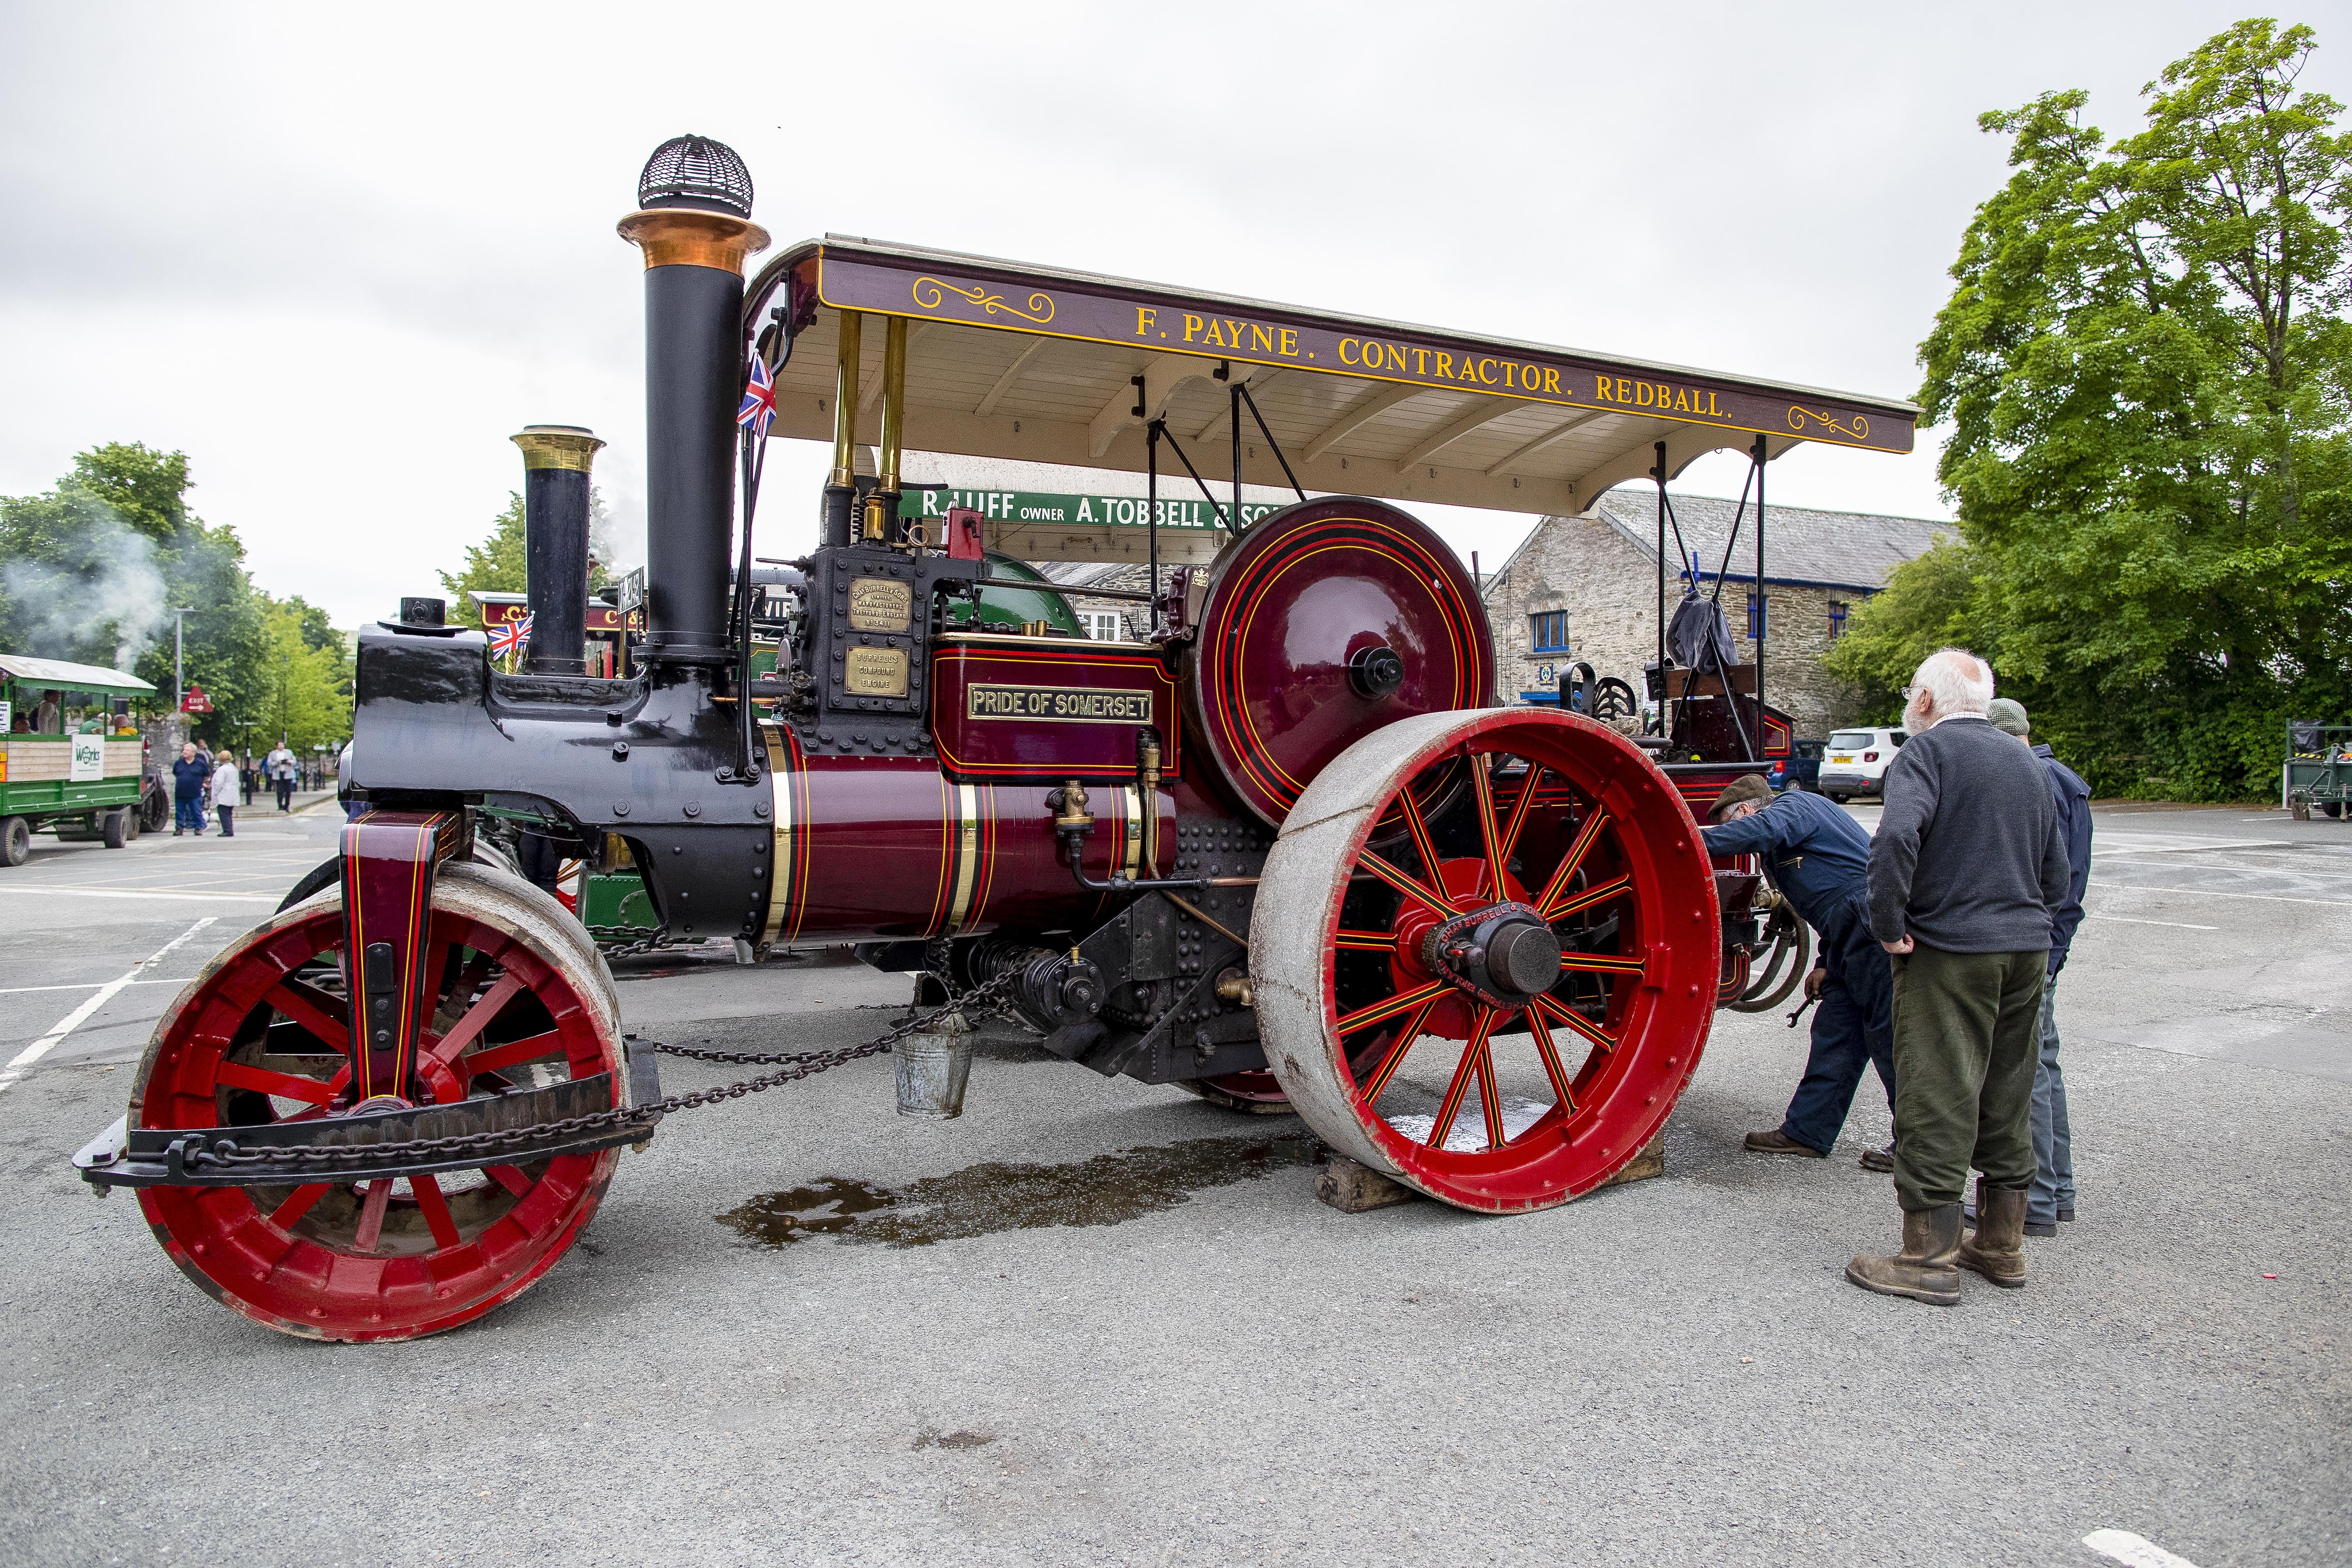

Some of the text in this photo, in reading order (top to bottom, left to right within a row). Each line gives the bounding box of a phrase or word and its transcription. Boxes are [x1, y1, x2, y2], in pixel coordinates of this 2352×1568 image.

[1135, 307, 1733, 418] F. PAYNE. CONTRACTOR. REDBALL.
[1020, 507, 1065, 521] OWNER
[864, 585, 890, 593] BURRELL
[893, 589, 908, 603] SONS
[858, 601, 904, 610] MANUFACTURERS.
[883, 611, 907, 619] ENGLAND.
[857, 653, 898, 663] BURRELL'S
[859, 666, 895, 675] COMPOUND
[861, 679, 890, 688] ENGINE
[973, 692, 1148, 717] PRIDE OF SOMERSET
[76, 746, 100, 764] Works
[1464, 905, 1508, 928] BURRELL
